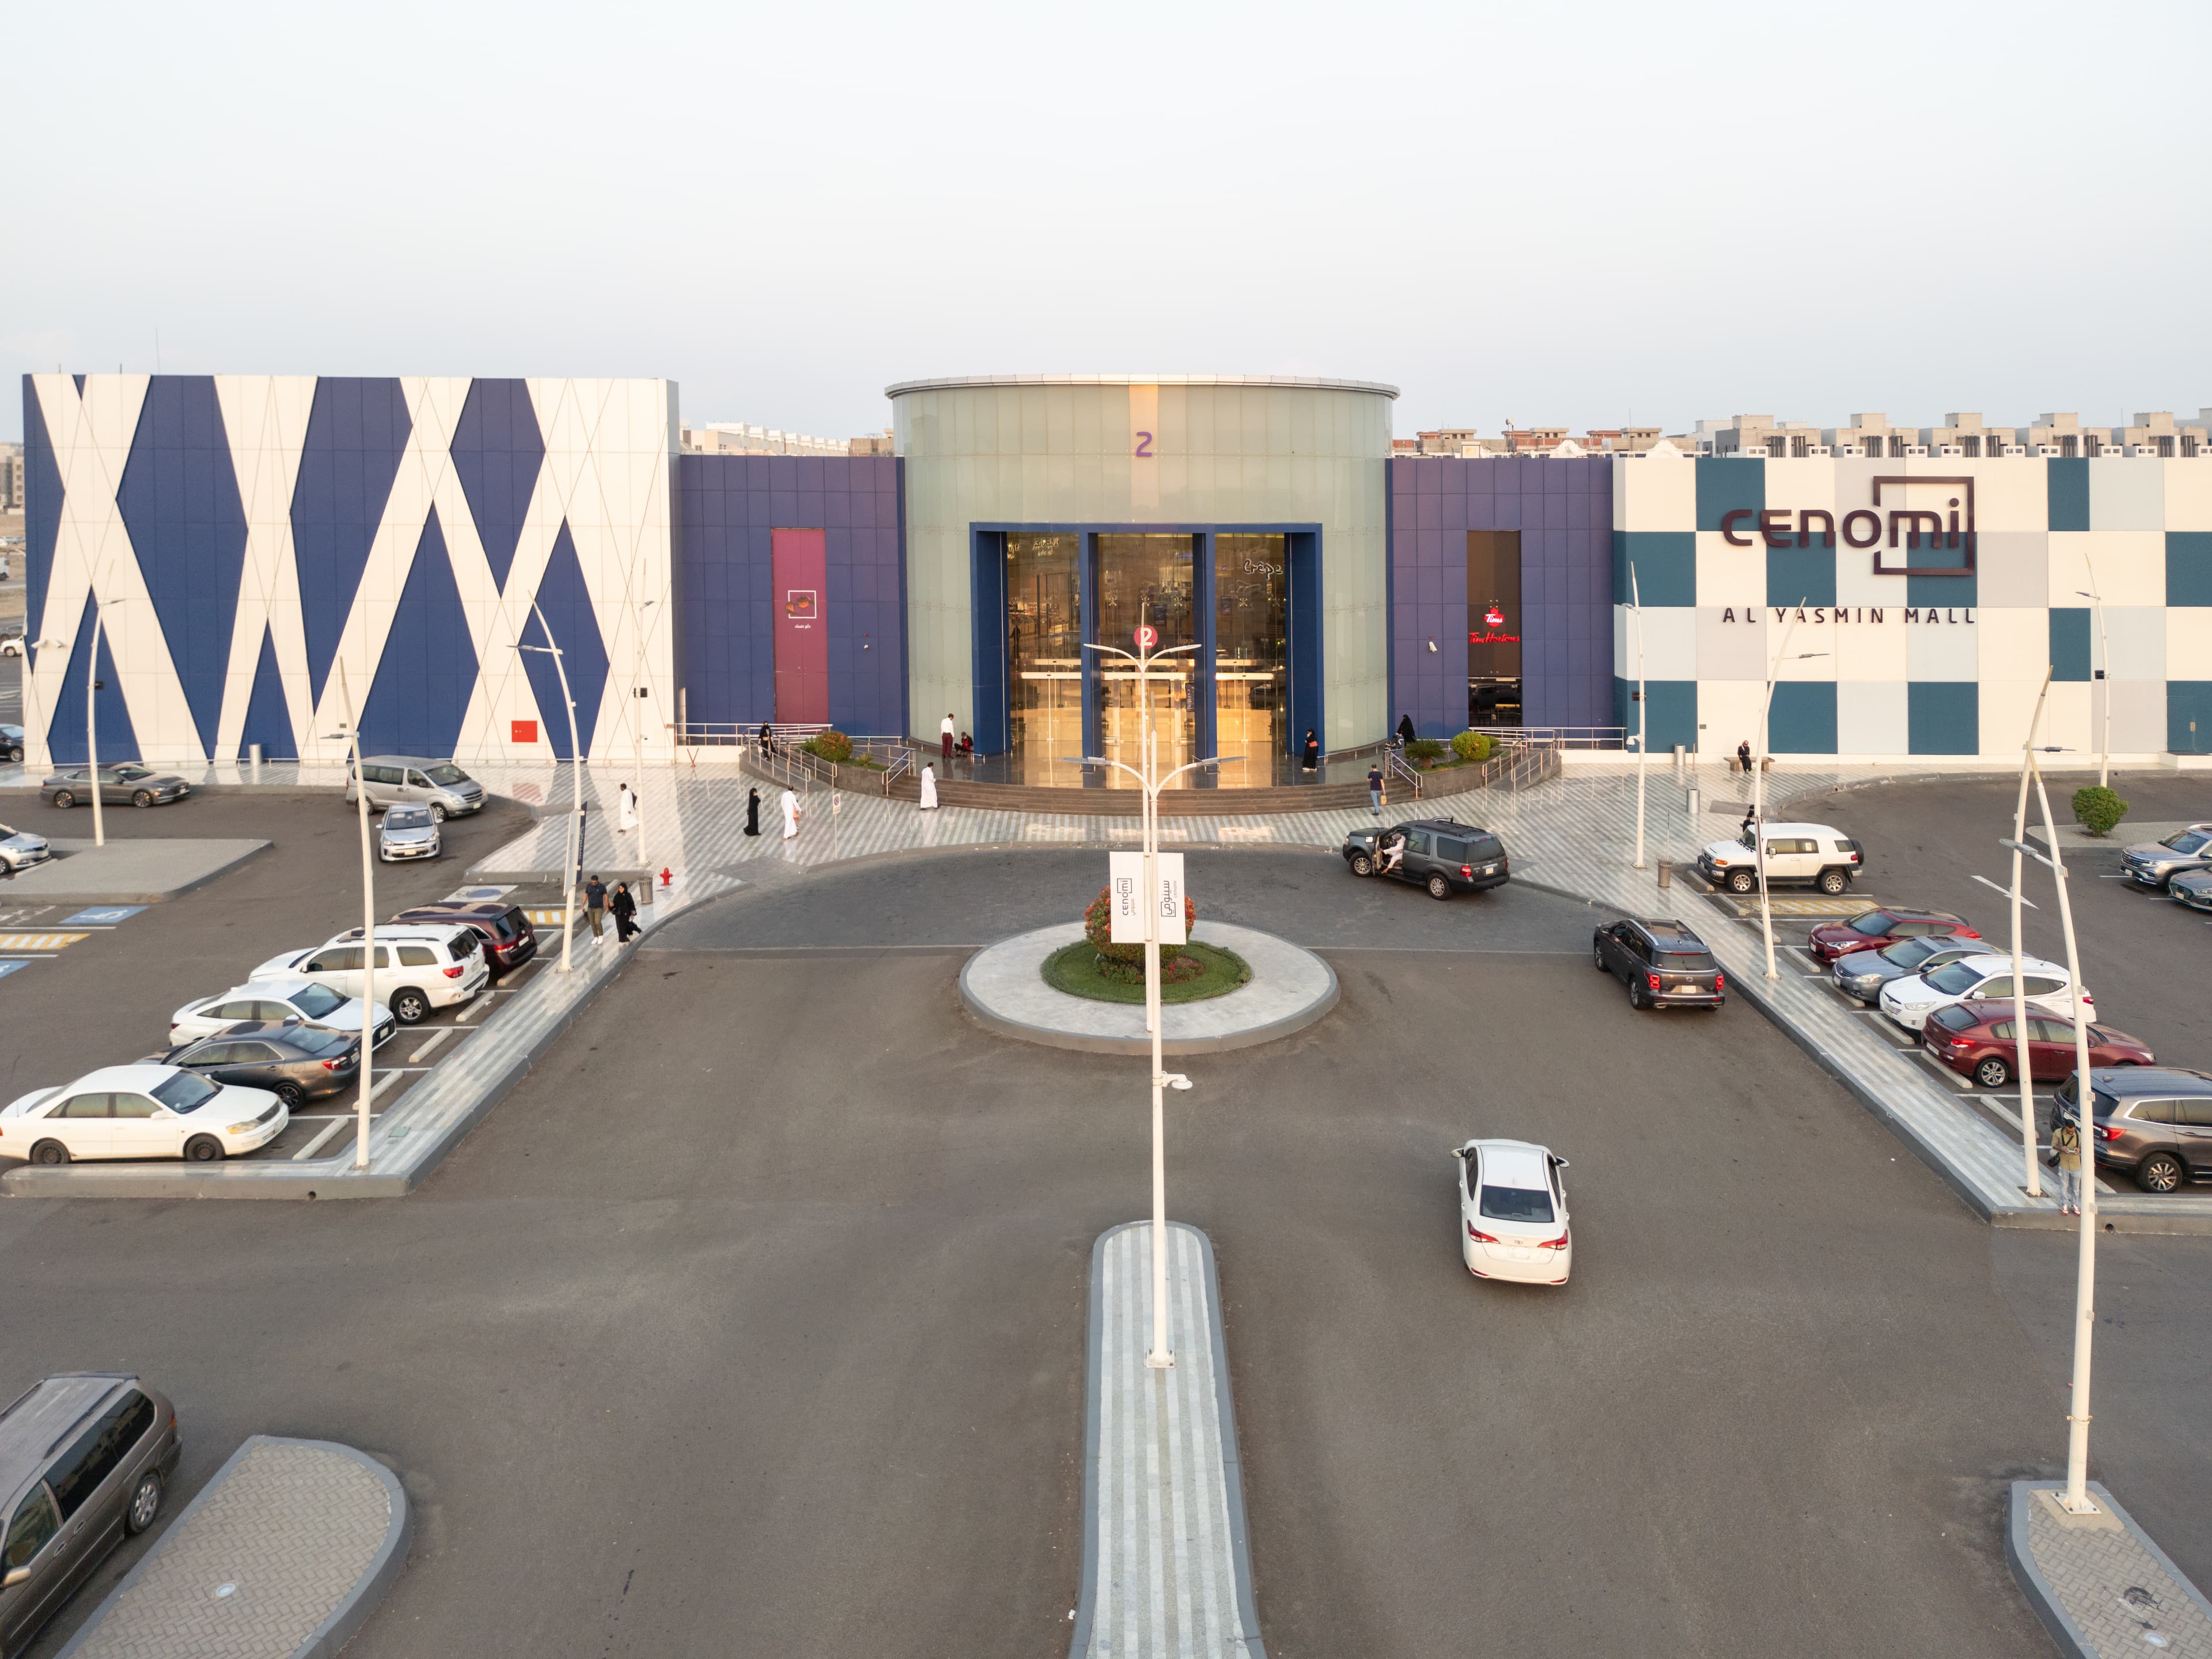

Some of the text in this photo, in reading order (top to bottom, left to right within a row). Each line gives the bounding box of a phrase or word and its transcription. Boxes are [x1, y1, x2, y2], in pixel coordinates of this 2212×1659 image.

[1136, 431, 1152, 457] 2
[1244, 558, 1283, 580] Crêpe
[1485, 613, 1503, 623] Tims
[1723, 607, 1975, 624] AL YASMIN MALL
[1140, 627, 1153, 646] 2
[1469, 631, 1520, 643] Tim Hortons
